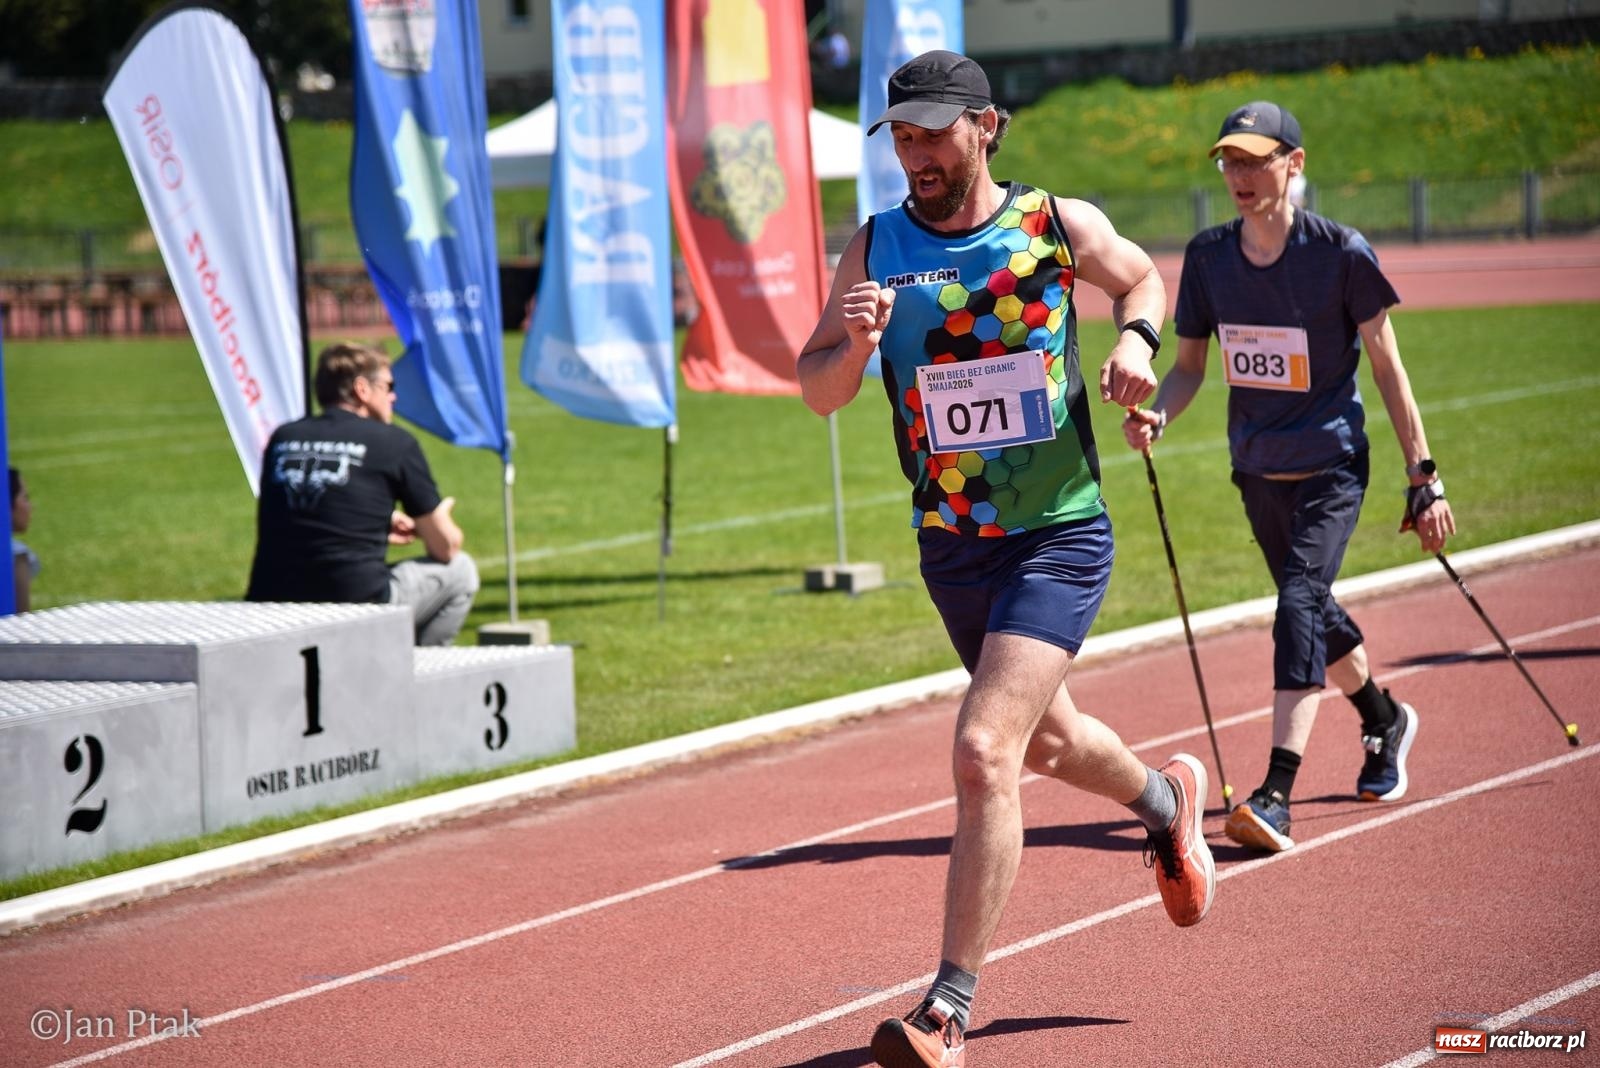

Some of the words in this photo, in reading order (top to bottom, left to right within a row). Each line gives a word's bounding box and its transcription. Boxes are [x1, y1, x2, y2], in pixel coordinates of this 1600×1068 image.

[887, 274, 916, 288] PWR
[917, 269, 958, 284] TEAM
[926, 372, 945, 382] XVIII
[946, 369, 966, 380] BIEG
[967, 366, 982, 378] BEZ
[984, 361, 1016, 375] GRANIC
[1233, 352, 1285, 377] 083
[927, 379, 974, 392] 3MAJA2026
[946, 397, 1009, 436] 071
[300, 646, 324, 738] 1
[484, 682, 509, 751] 3
[64, 734, 108, 838] 2
[247, 770, 289, 799] OSIR
